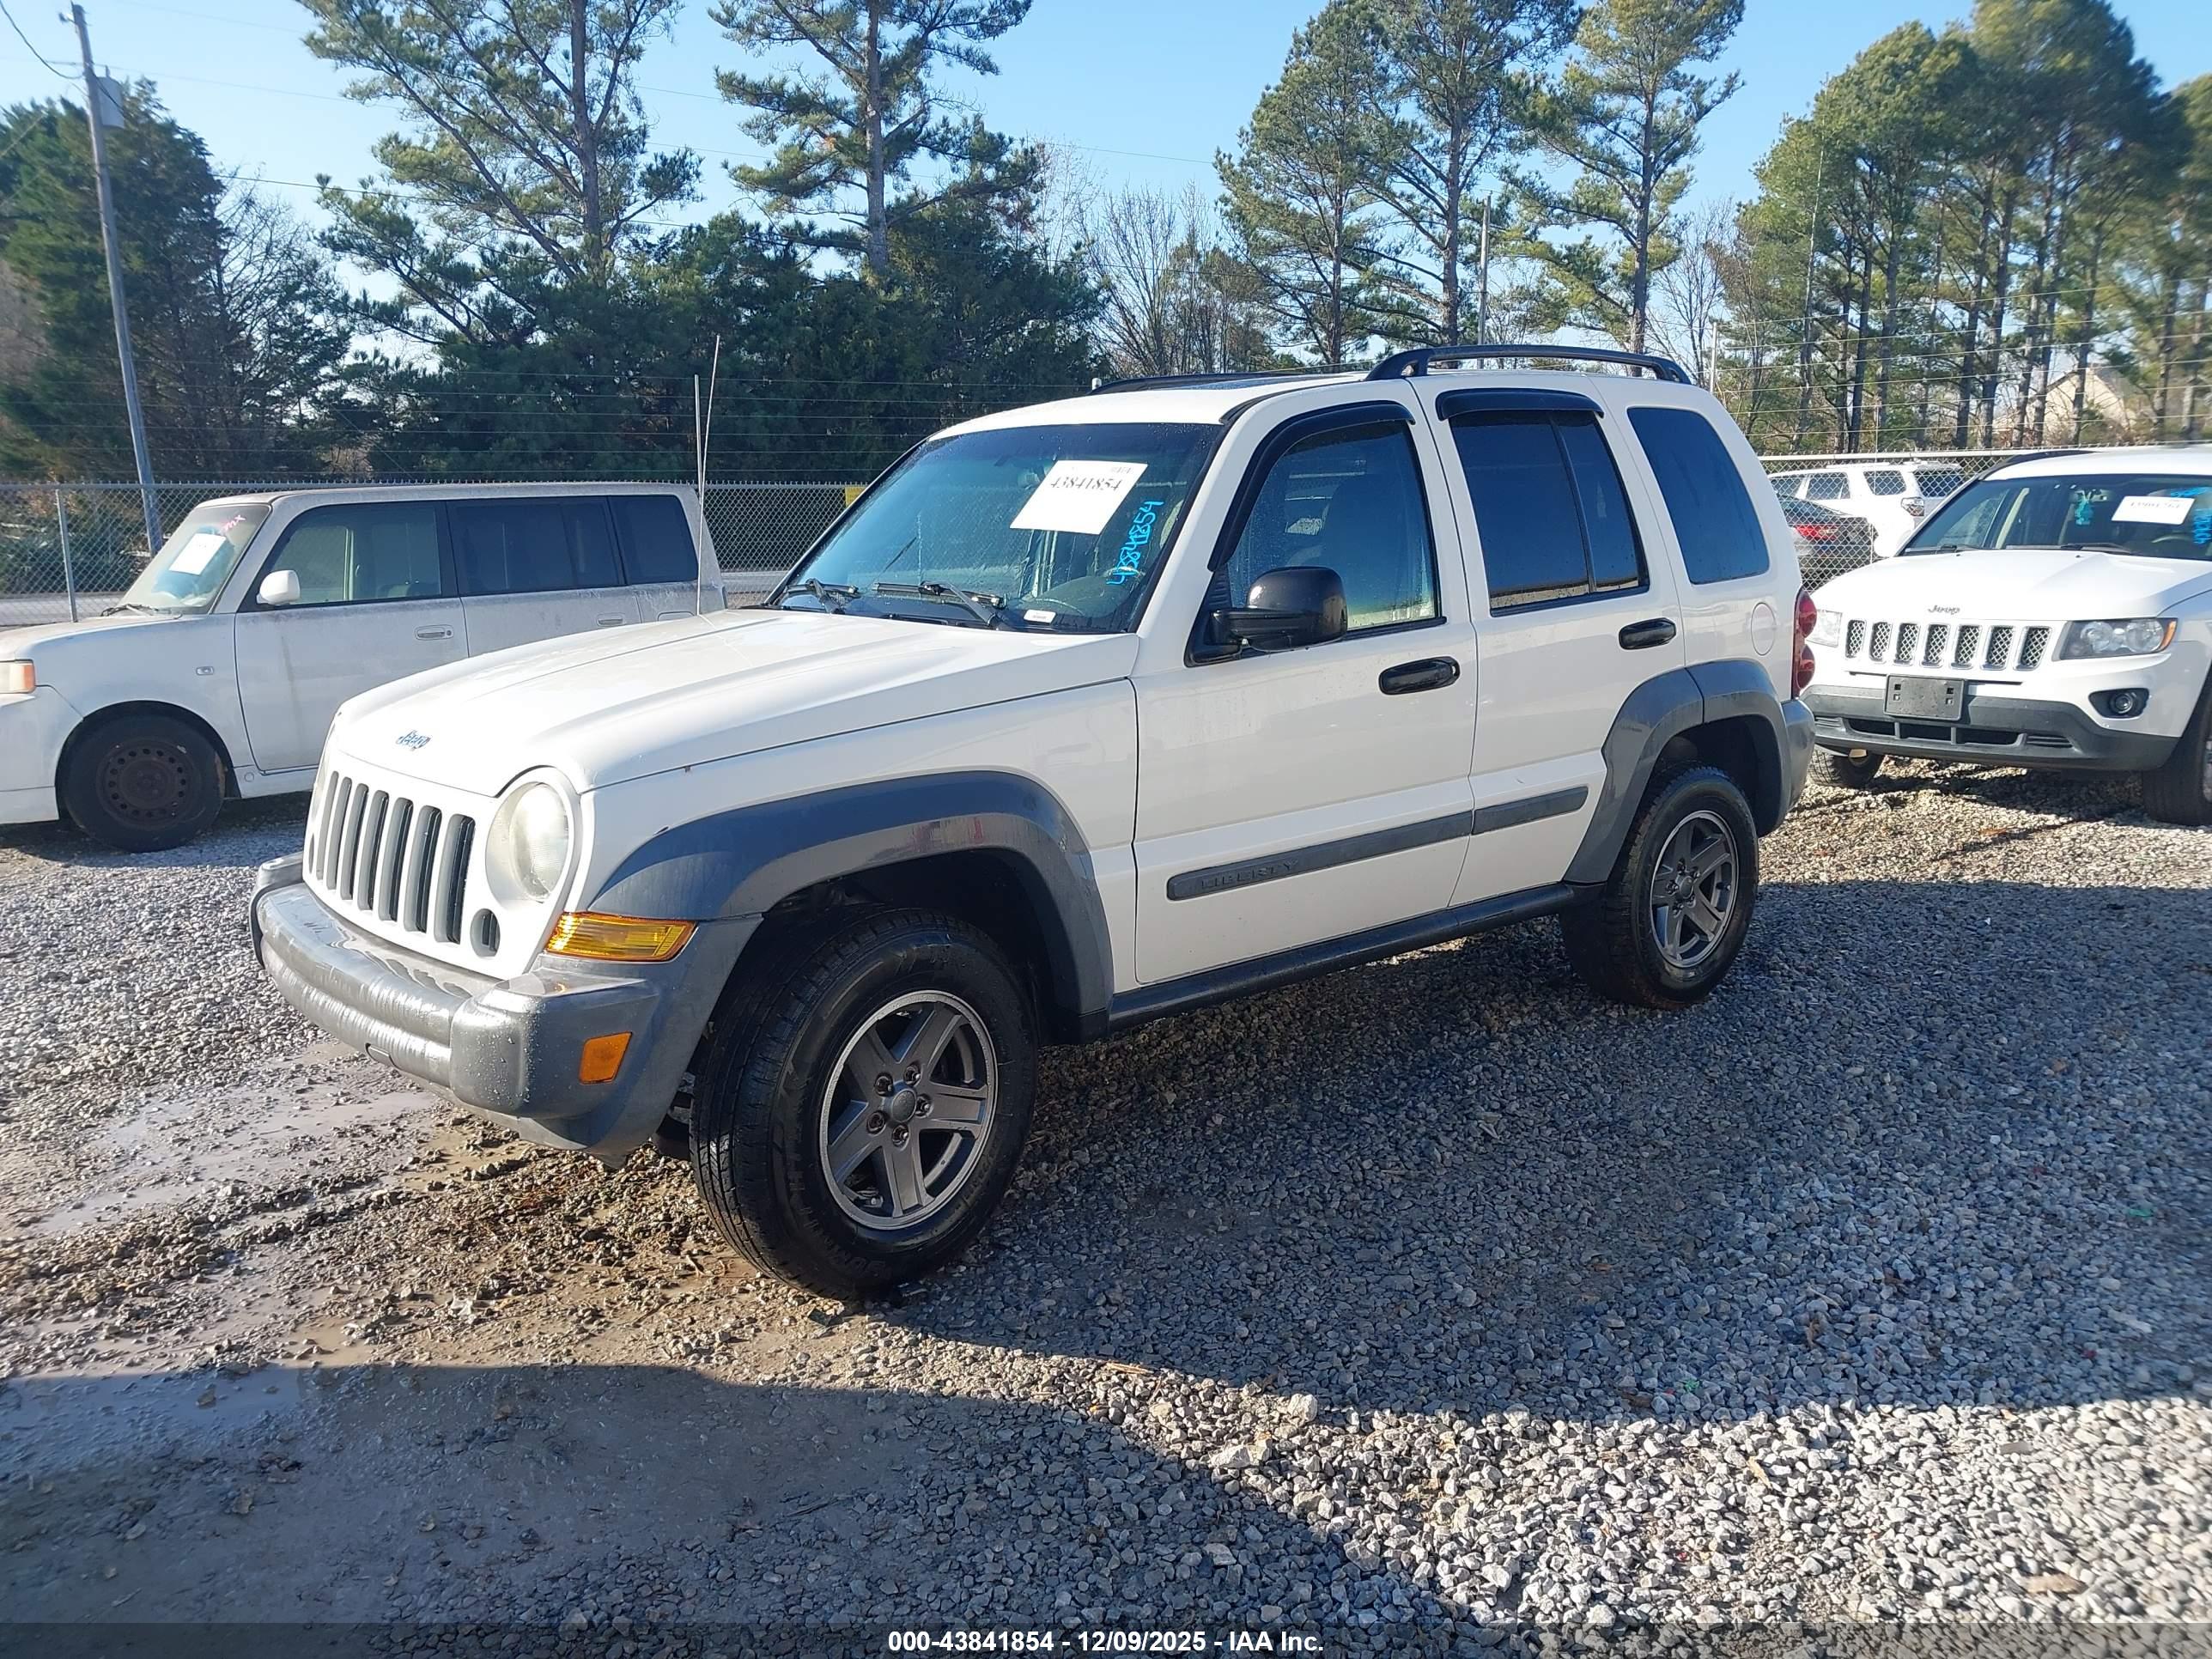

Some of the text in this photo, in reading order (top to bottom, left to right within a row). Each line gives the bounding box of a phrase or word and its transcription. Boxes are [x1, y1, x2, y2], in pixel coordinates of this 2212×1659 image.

[1050, 477, 1123, 492] 43841854
[1106, 501, 1164, 585] 43841854
[1927, 604, 1960, 616] Jeep
